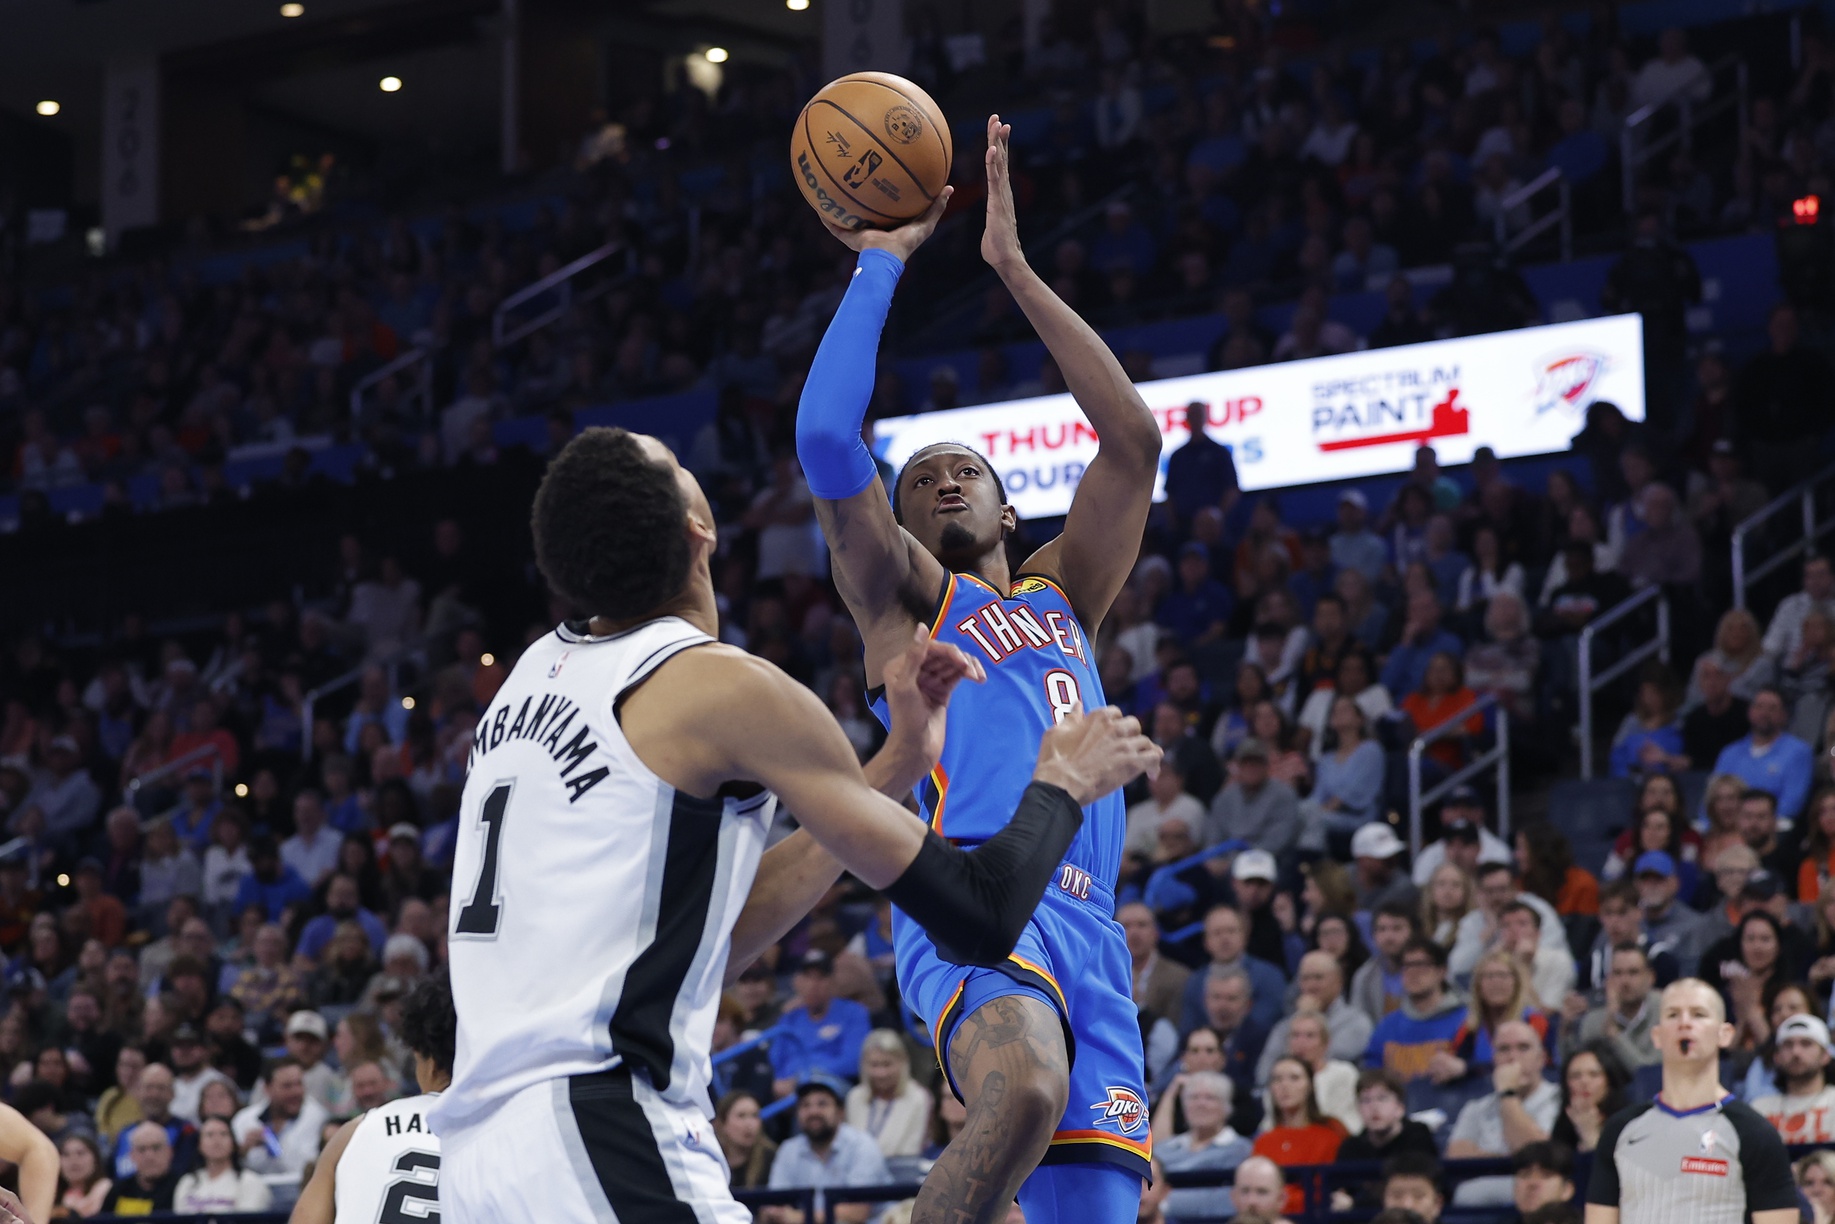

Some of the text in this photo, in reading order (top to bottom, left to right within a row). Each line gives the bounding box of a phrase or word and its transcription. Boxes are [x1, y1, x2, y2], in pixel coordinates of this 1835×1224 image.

[1205, 396, 1263, 428] UP
[1312, 394, 1429, 433] PAINT
[1004, 460, 1086, 494] OUR
[468, 692, 611, 805] MBANYAMA
[451, 778, 516, 940] 1
[1060, 865, 1092, 901] OKC
[384, 1112, 432, 1137] HA
[1106, 1098, 1140, 1118] OKC
